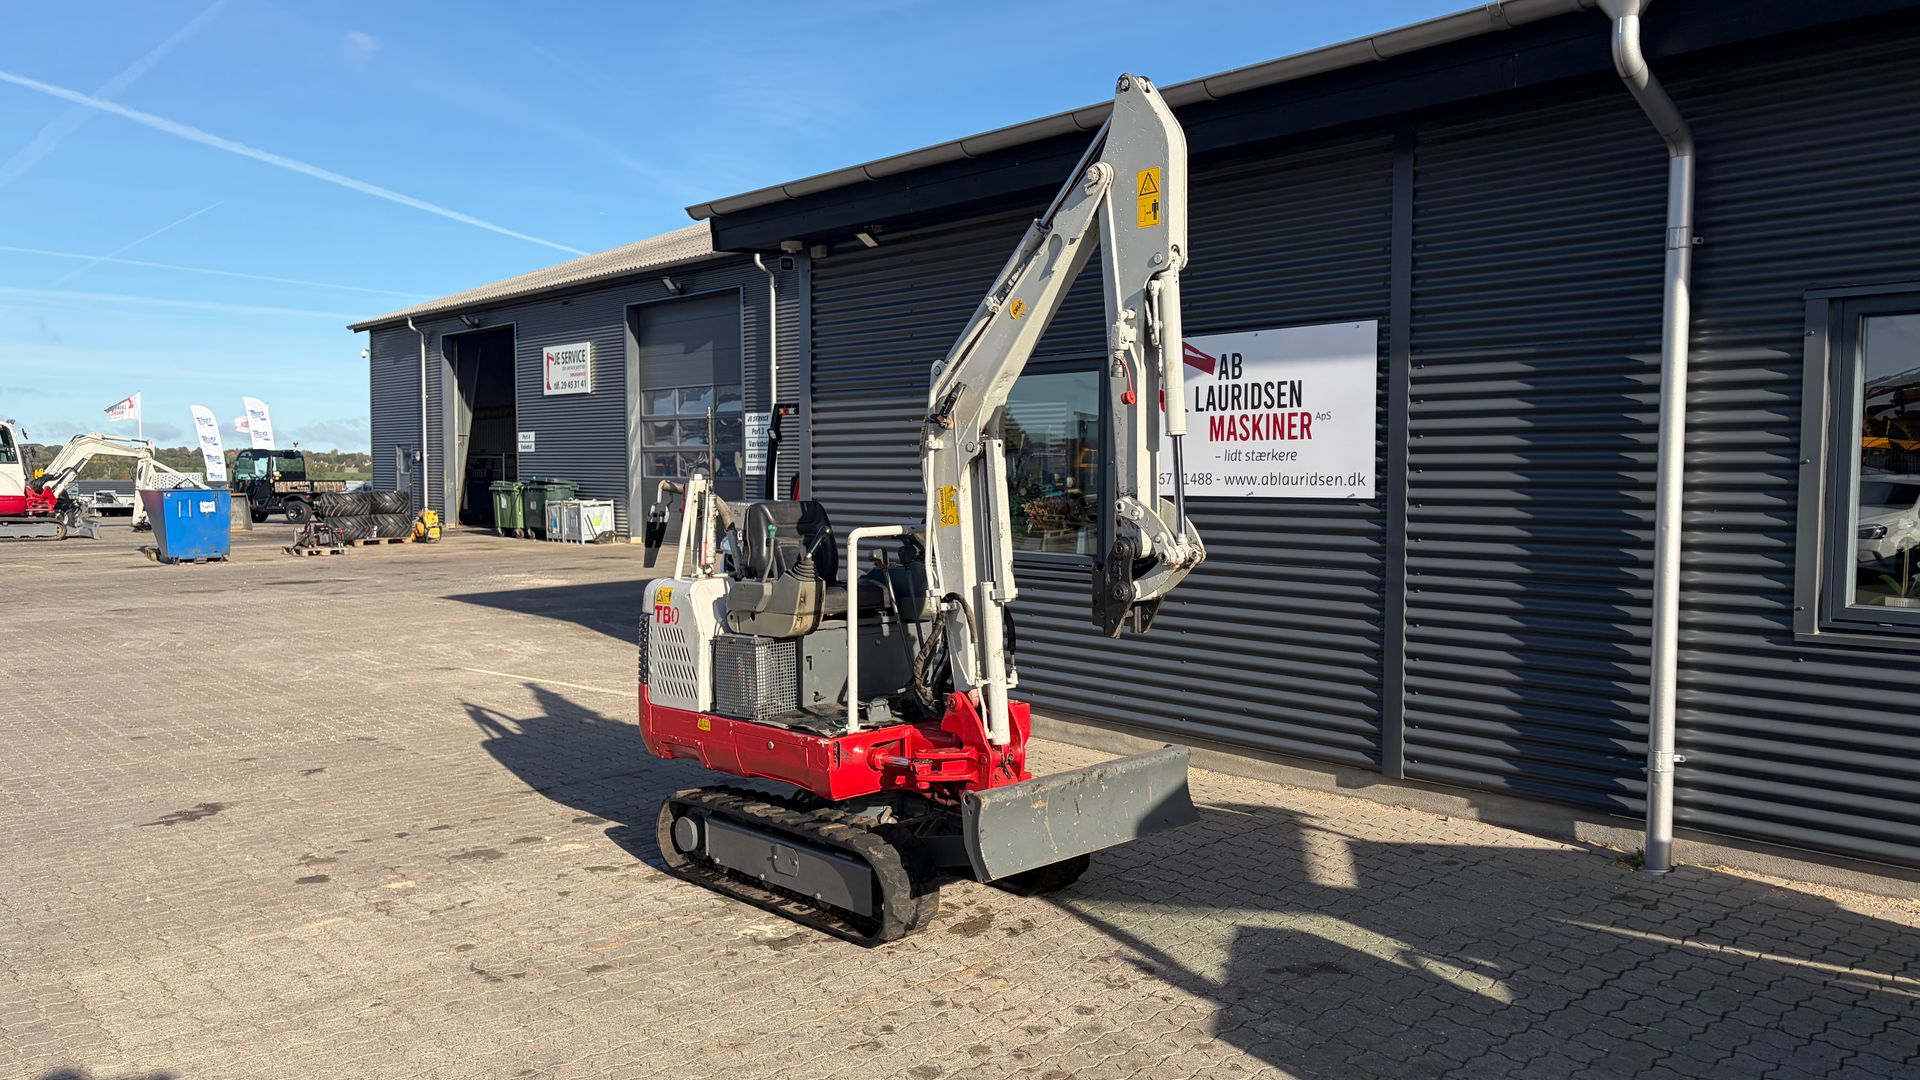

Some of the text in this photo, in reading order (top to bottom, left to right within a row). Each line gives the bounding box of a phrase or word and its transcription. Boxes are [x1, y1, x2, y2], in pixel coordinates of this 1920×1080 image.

[554, 349, 586, 365] JE SERVICE
[1218, 352, 1243, 381] AB
[561, 381, 567, 390] 29
[568, 380, 574, 389] 45
[1195, 379, 1303, 413] LAURIDSEN
[1209, 411, 1332, 442] MASKINER ApS
[1224, 449, 1242, 461] lidt
[1244, 448, 1298, 461] stærkere
[1224, 471, 1366, 487] www.ablauridsen.dk
